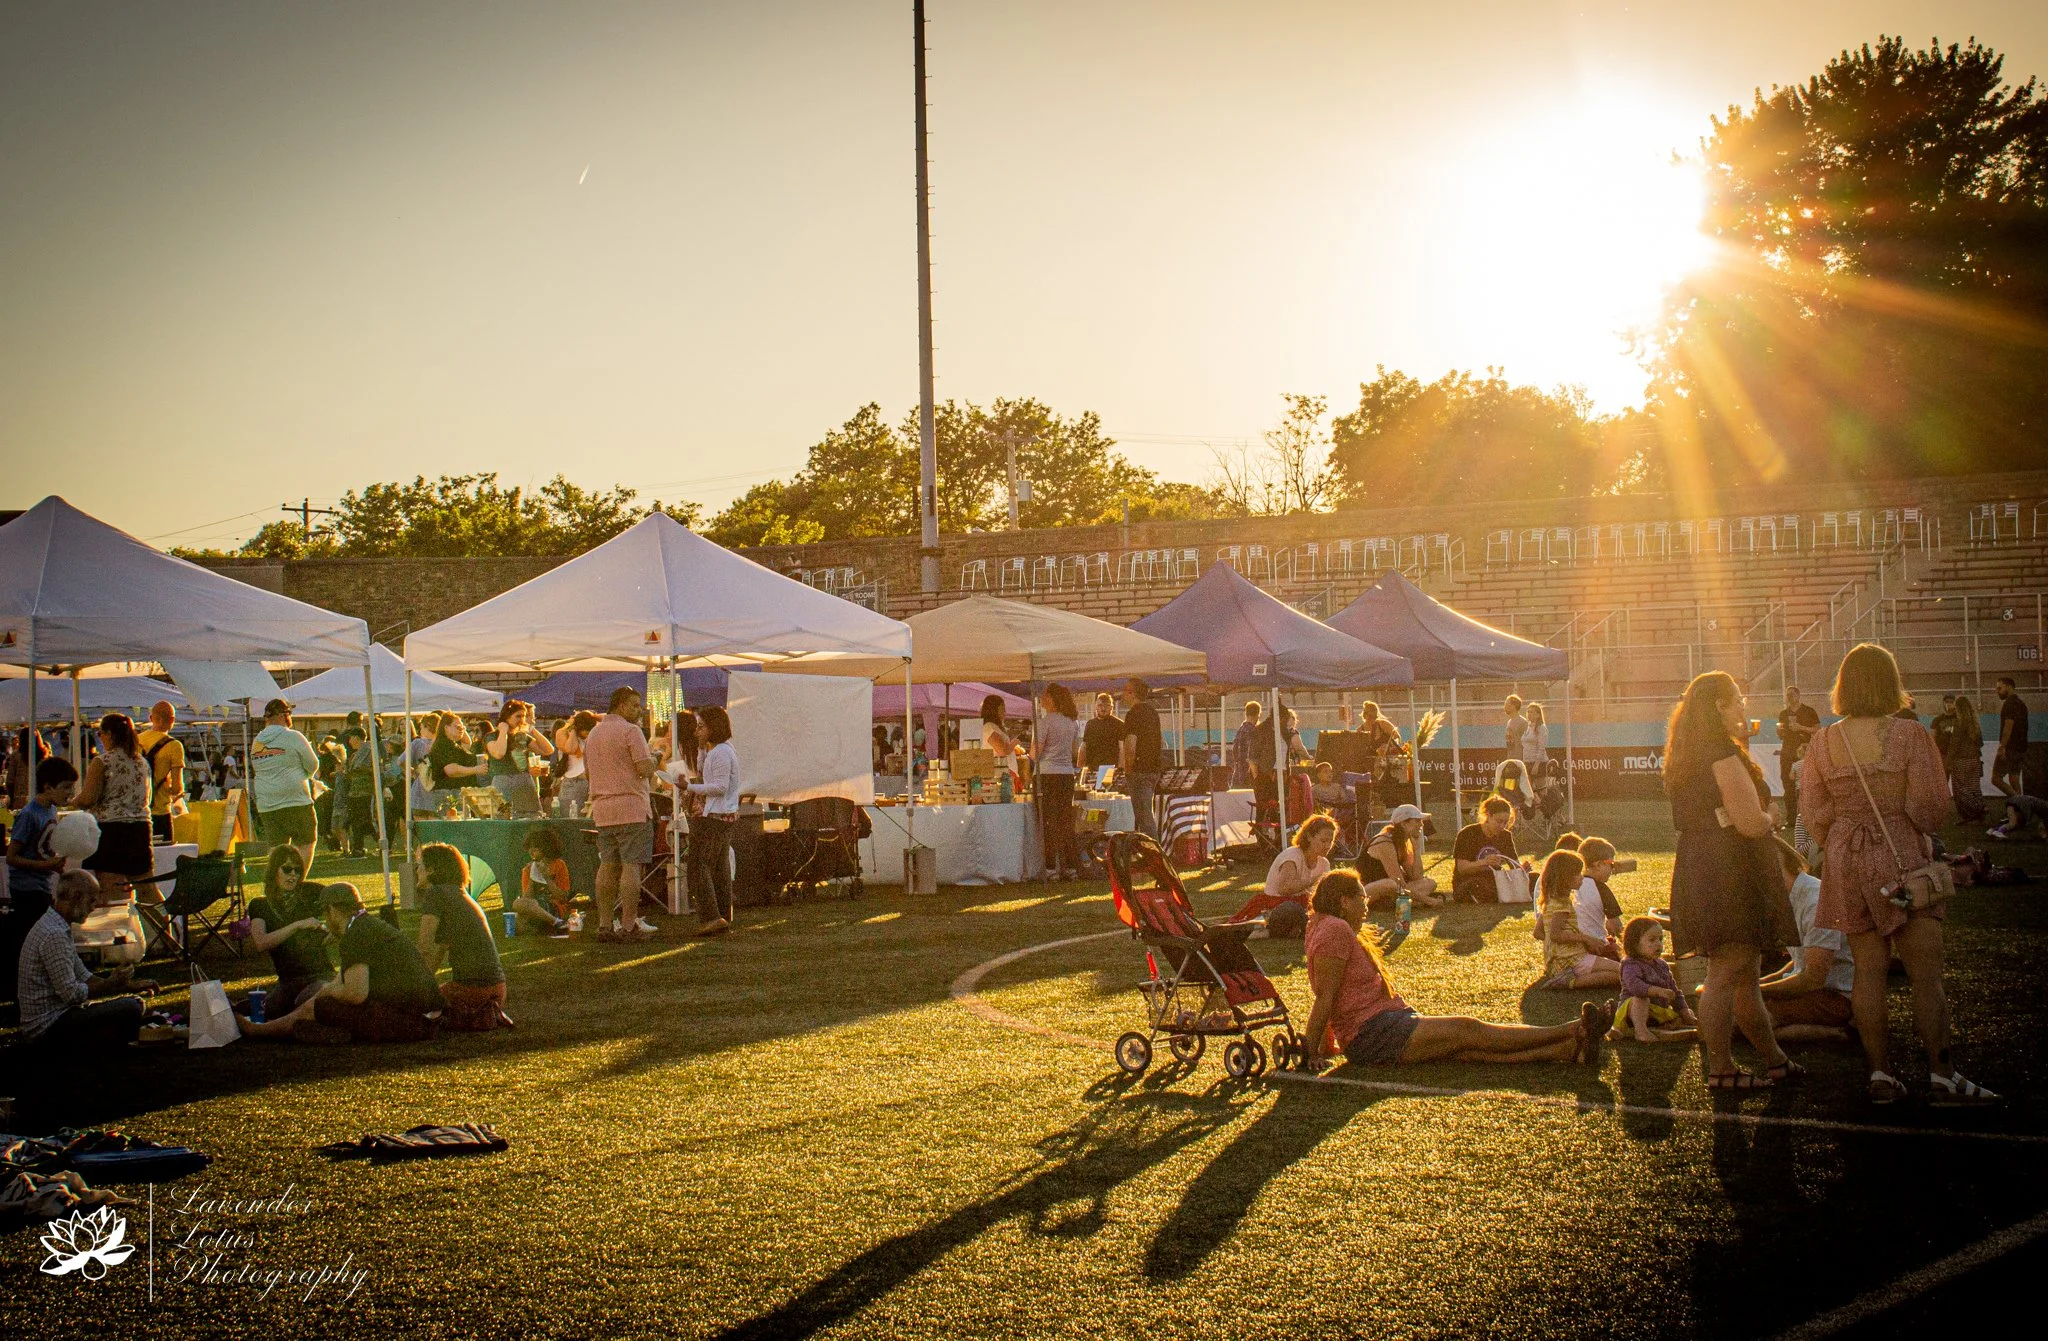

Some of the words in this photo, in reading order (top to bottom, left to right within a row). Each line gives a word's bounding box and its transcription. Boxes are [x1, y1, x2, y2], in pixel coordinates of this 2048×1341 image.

[2018, 648, 2037, 659] 106
[1449, 762, 1465, 773] gt
[1469, 763, 1475, 771] a
[1562, 759, 1611, 770] CARBON!
[1476, 777, 1488, 785] us
